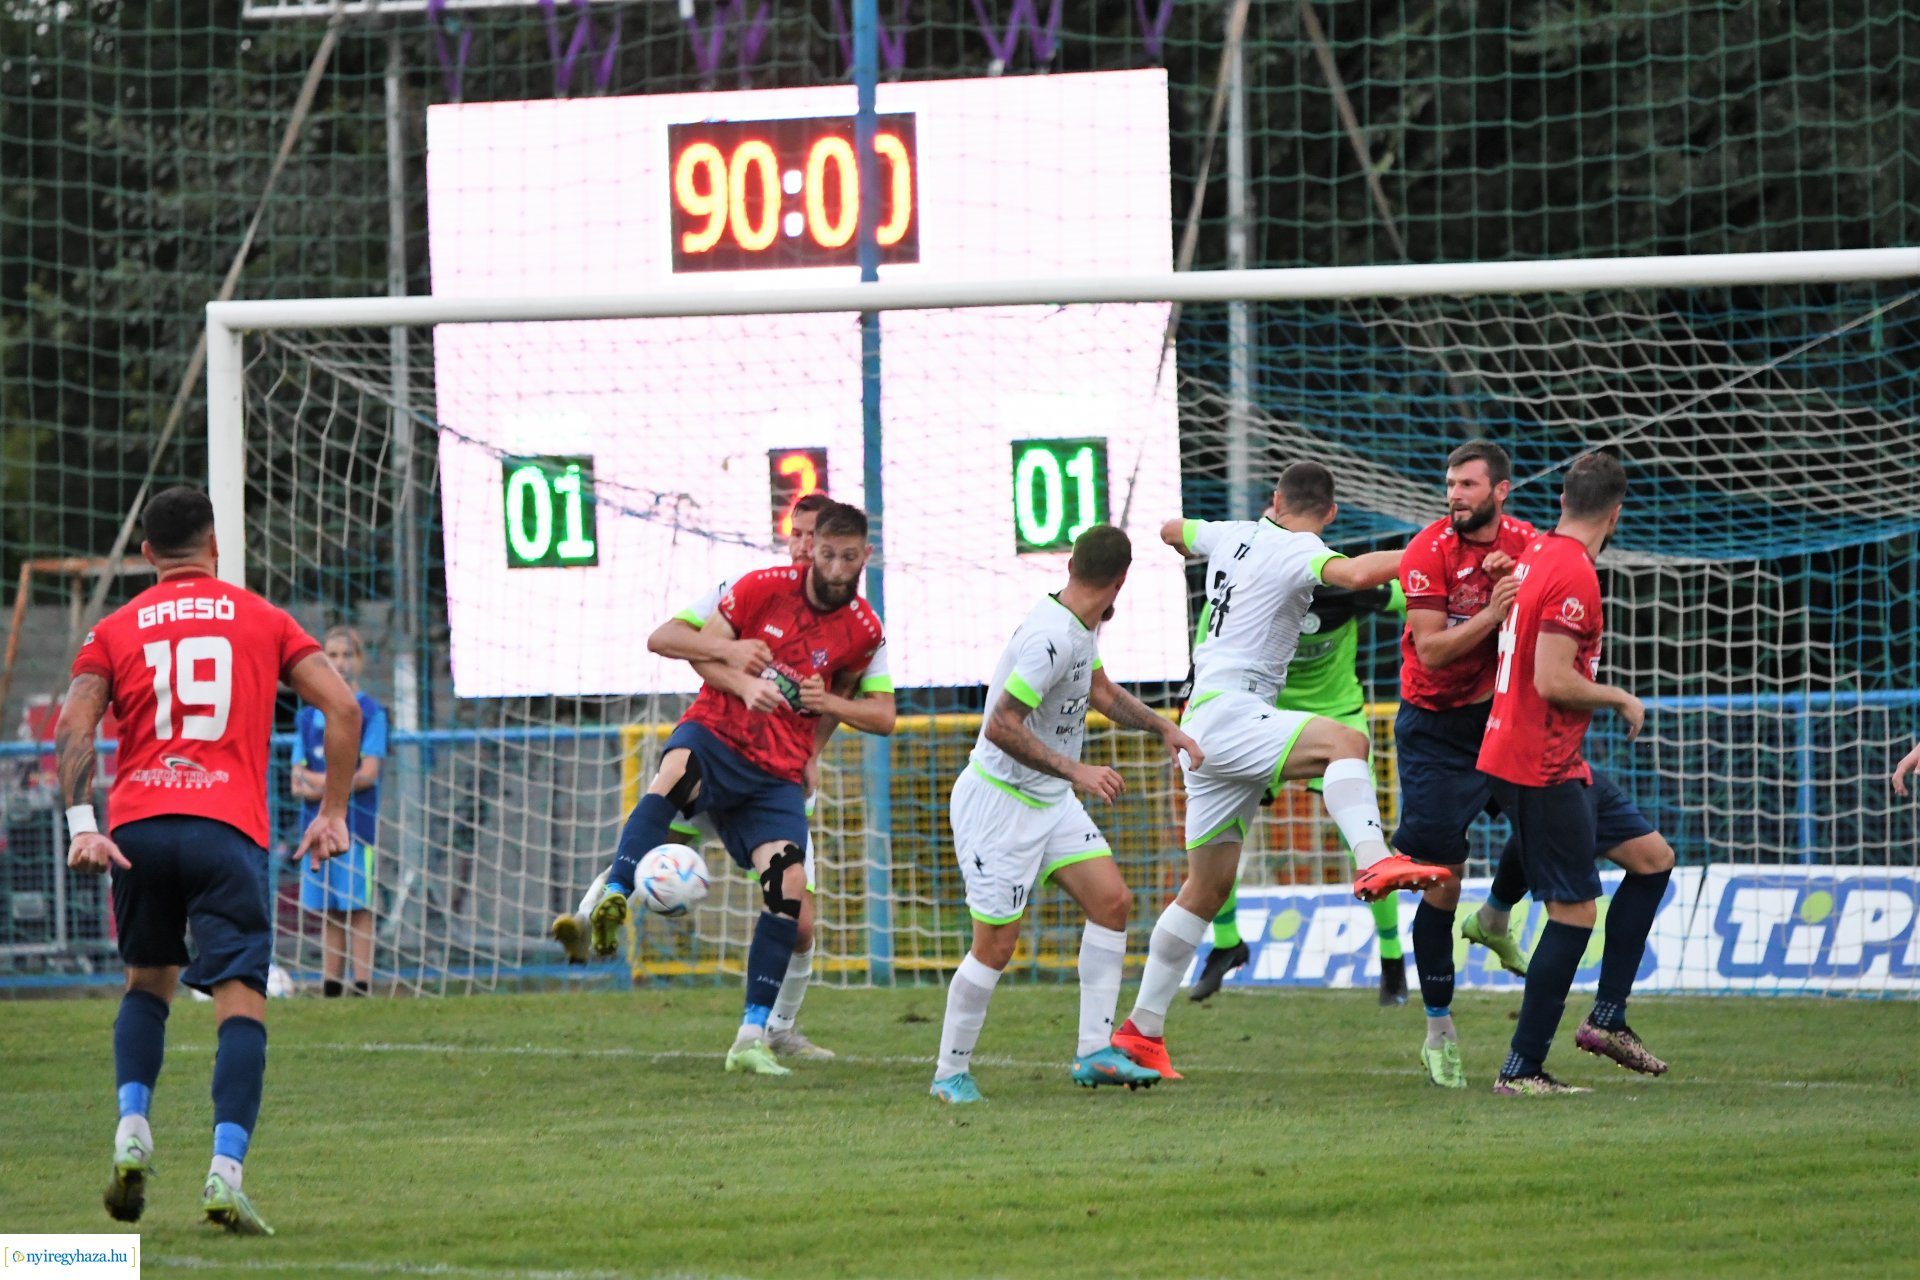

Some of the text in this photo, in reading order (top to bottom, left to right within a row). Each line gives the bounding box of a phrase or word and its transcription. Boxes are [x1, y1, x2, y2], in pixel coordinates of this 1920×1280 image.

[675, 133, 912, 253] 90:00
[507, 464, 595, 561] 01
[1015, 447, 1096, 546] 01
[143, 636, 233, 741] 19
[1012, 884, 1025, 908] 17
[1728, 888, 1920, 965] TiP
